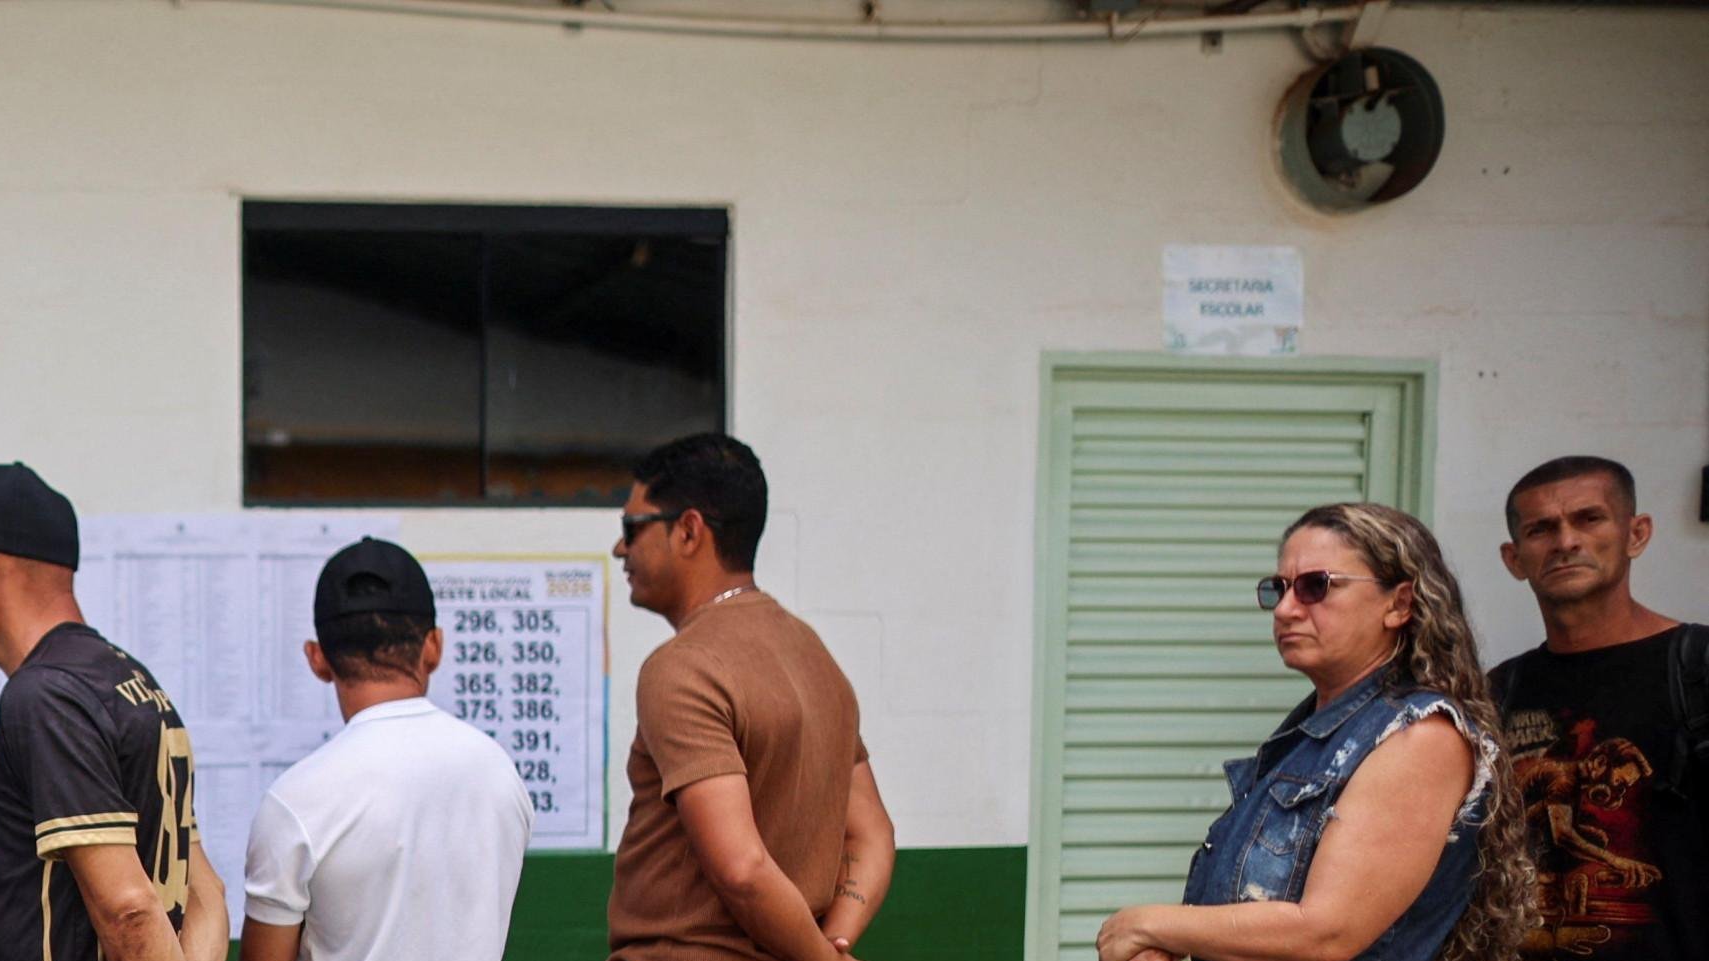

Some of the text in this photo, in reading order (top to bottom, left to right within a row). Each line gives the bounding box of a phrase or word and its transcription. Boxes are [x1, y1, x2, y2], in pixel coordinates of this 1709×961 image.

[1188, 278, 1274, 293] SECRETARIA
[1199, 303, 1265, 317] ESCOLAR
[480, 588, 532, 601] LOCAL
[454, 609, 561, 634] 296, 305,
[454, 641, 561, 667] 326, 350,
[454, 673, 560, 697] 365, 382,
[455, 699, 561, 724] 375, 386,
[511, 729, 561, 755] 391,
